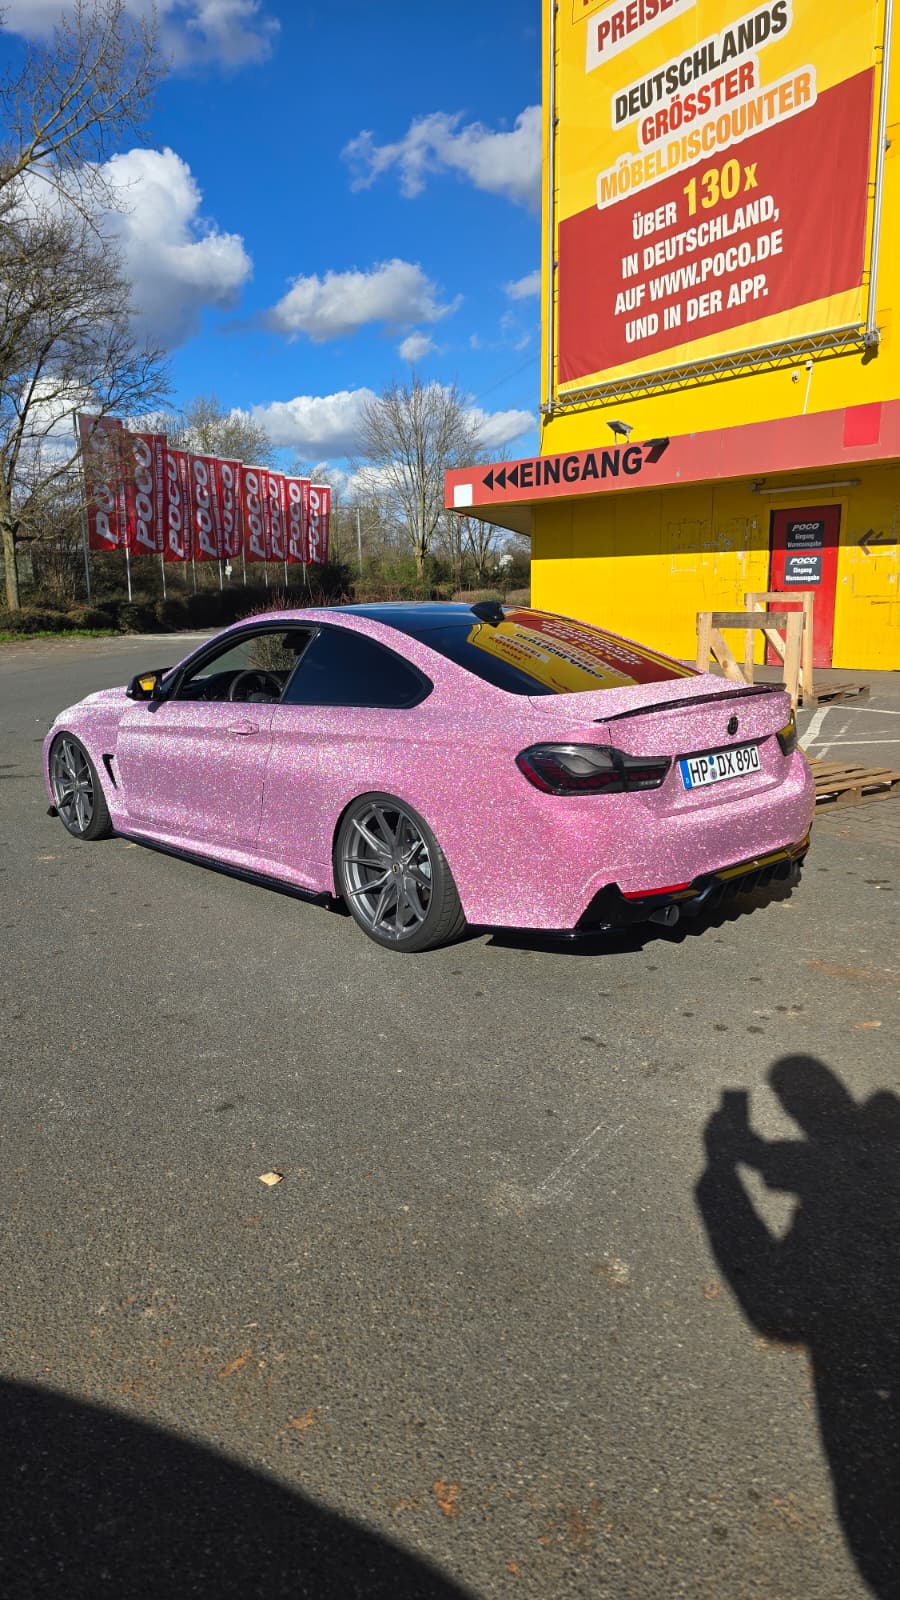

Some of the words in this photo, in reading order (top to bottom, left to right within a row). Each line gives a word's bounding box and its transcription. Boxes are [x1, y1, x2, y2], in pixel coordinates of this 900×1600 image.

[615, 0, 788, 124] DEUTSCHLANDS
[641, 61, 755, 145] GRÖSSTER
[600, 73, 812, 203] MÖBELDISCOUNTER
[621, 256, 639, 279] IN
[643, 195, 780, 271] DEUTSCHLAND,
[632, 202, 677, 241] ÜBER
[614, 287, 646, 315] AUF
[649, 229, 783, 301] WWW.POCO.DE
[625, 313, 659, 343] UND
[663, 305, 682, 330] IN
[686, 292, 722, 323] DER
[727, 274, 769, 307] APP.
[133, 438, 156, 550] POCO
[194, 460, 218, 558] POCO
[519, 447, 643, 488] EINGANG
[246, 472, 266, 558] POCO
[289, 482, 304, 560] POCO
[792, 523, 820, 531] POCO
[790, 557, 818, 565] POCO
[690, 759, 708, 783] HP
[716, 754, 735, 777] DX
[736, 748, 759, 771] 890
